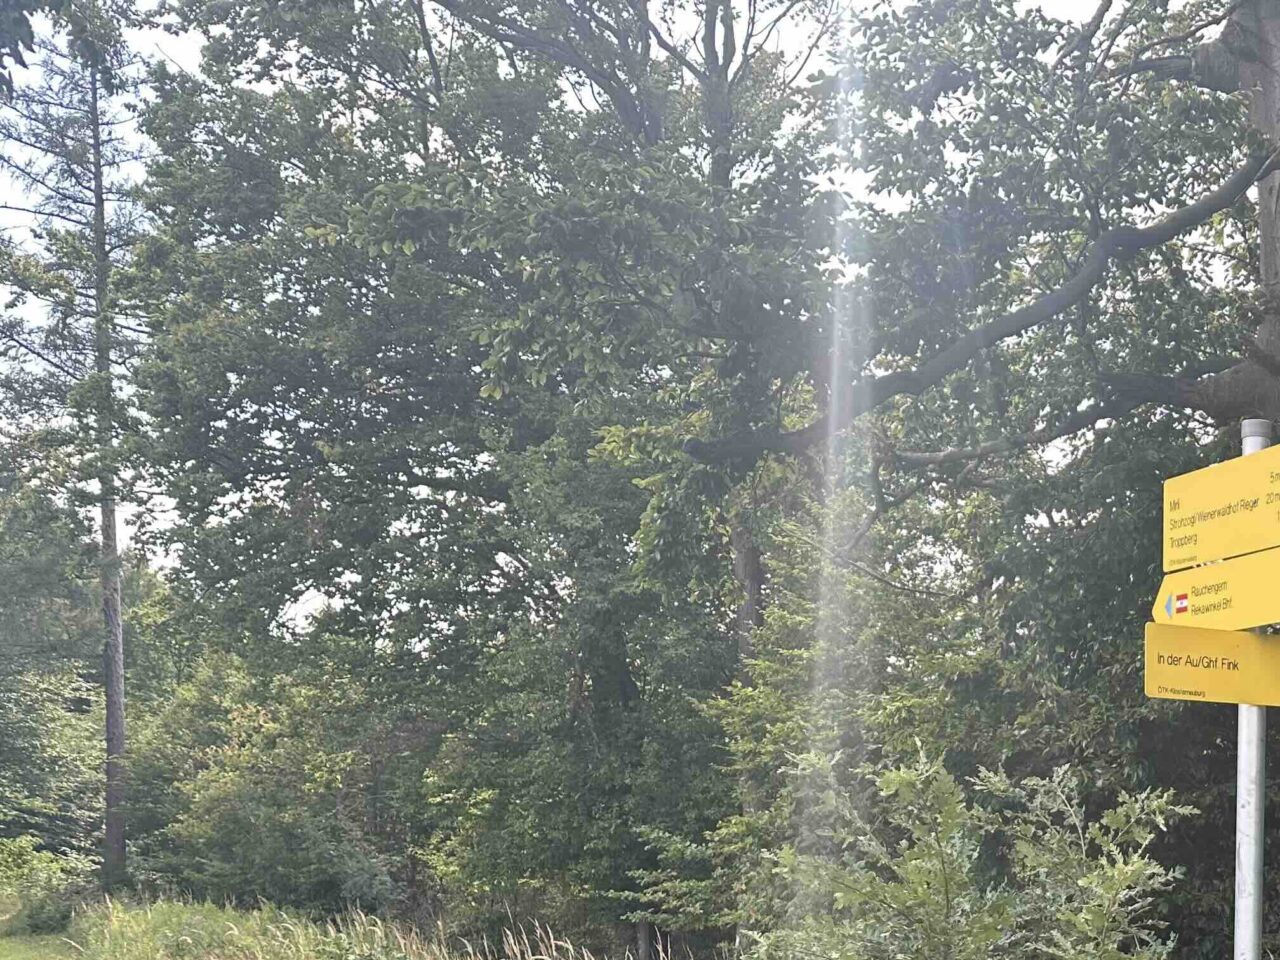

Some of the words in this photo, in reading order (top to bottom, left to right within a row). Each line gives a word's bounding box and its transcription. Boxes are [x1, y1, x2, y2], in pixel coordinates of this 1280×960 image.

[1157, 653, 1166, 665] In
[1166, 653, 1182, 666] der
[1185, 655, 1218, 669] Au/Ghf
[1221, 658, 1240, 671] Fink
